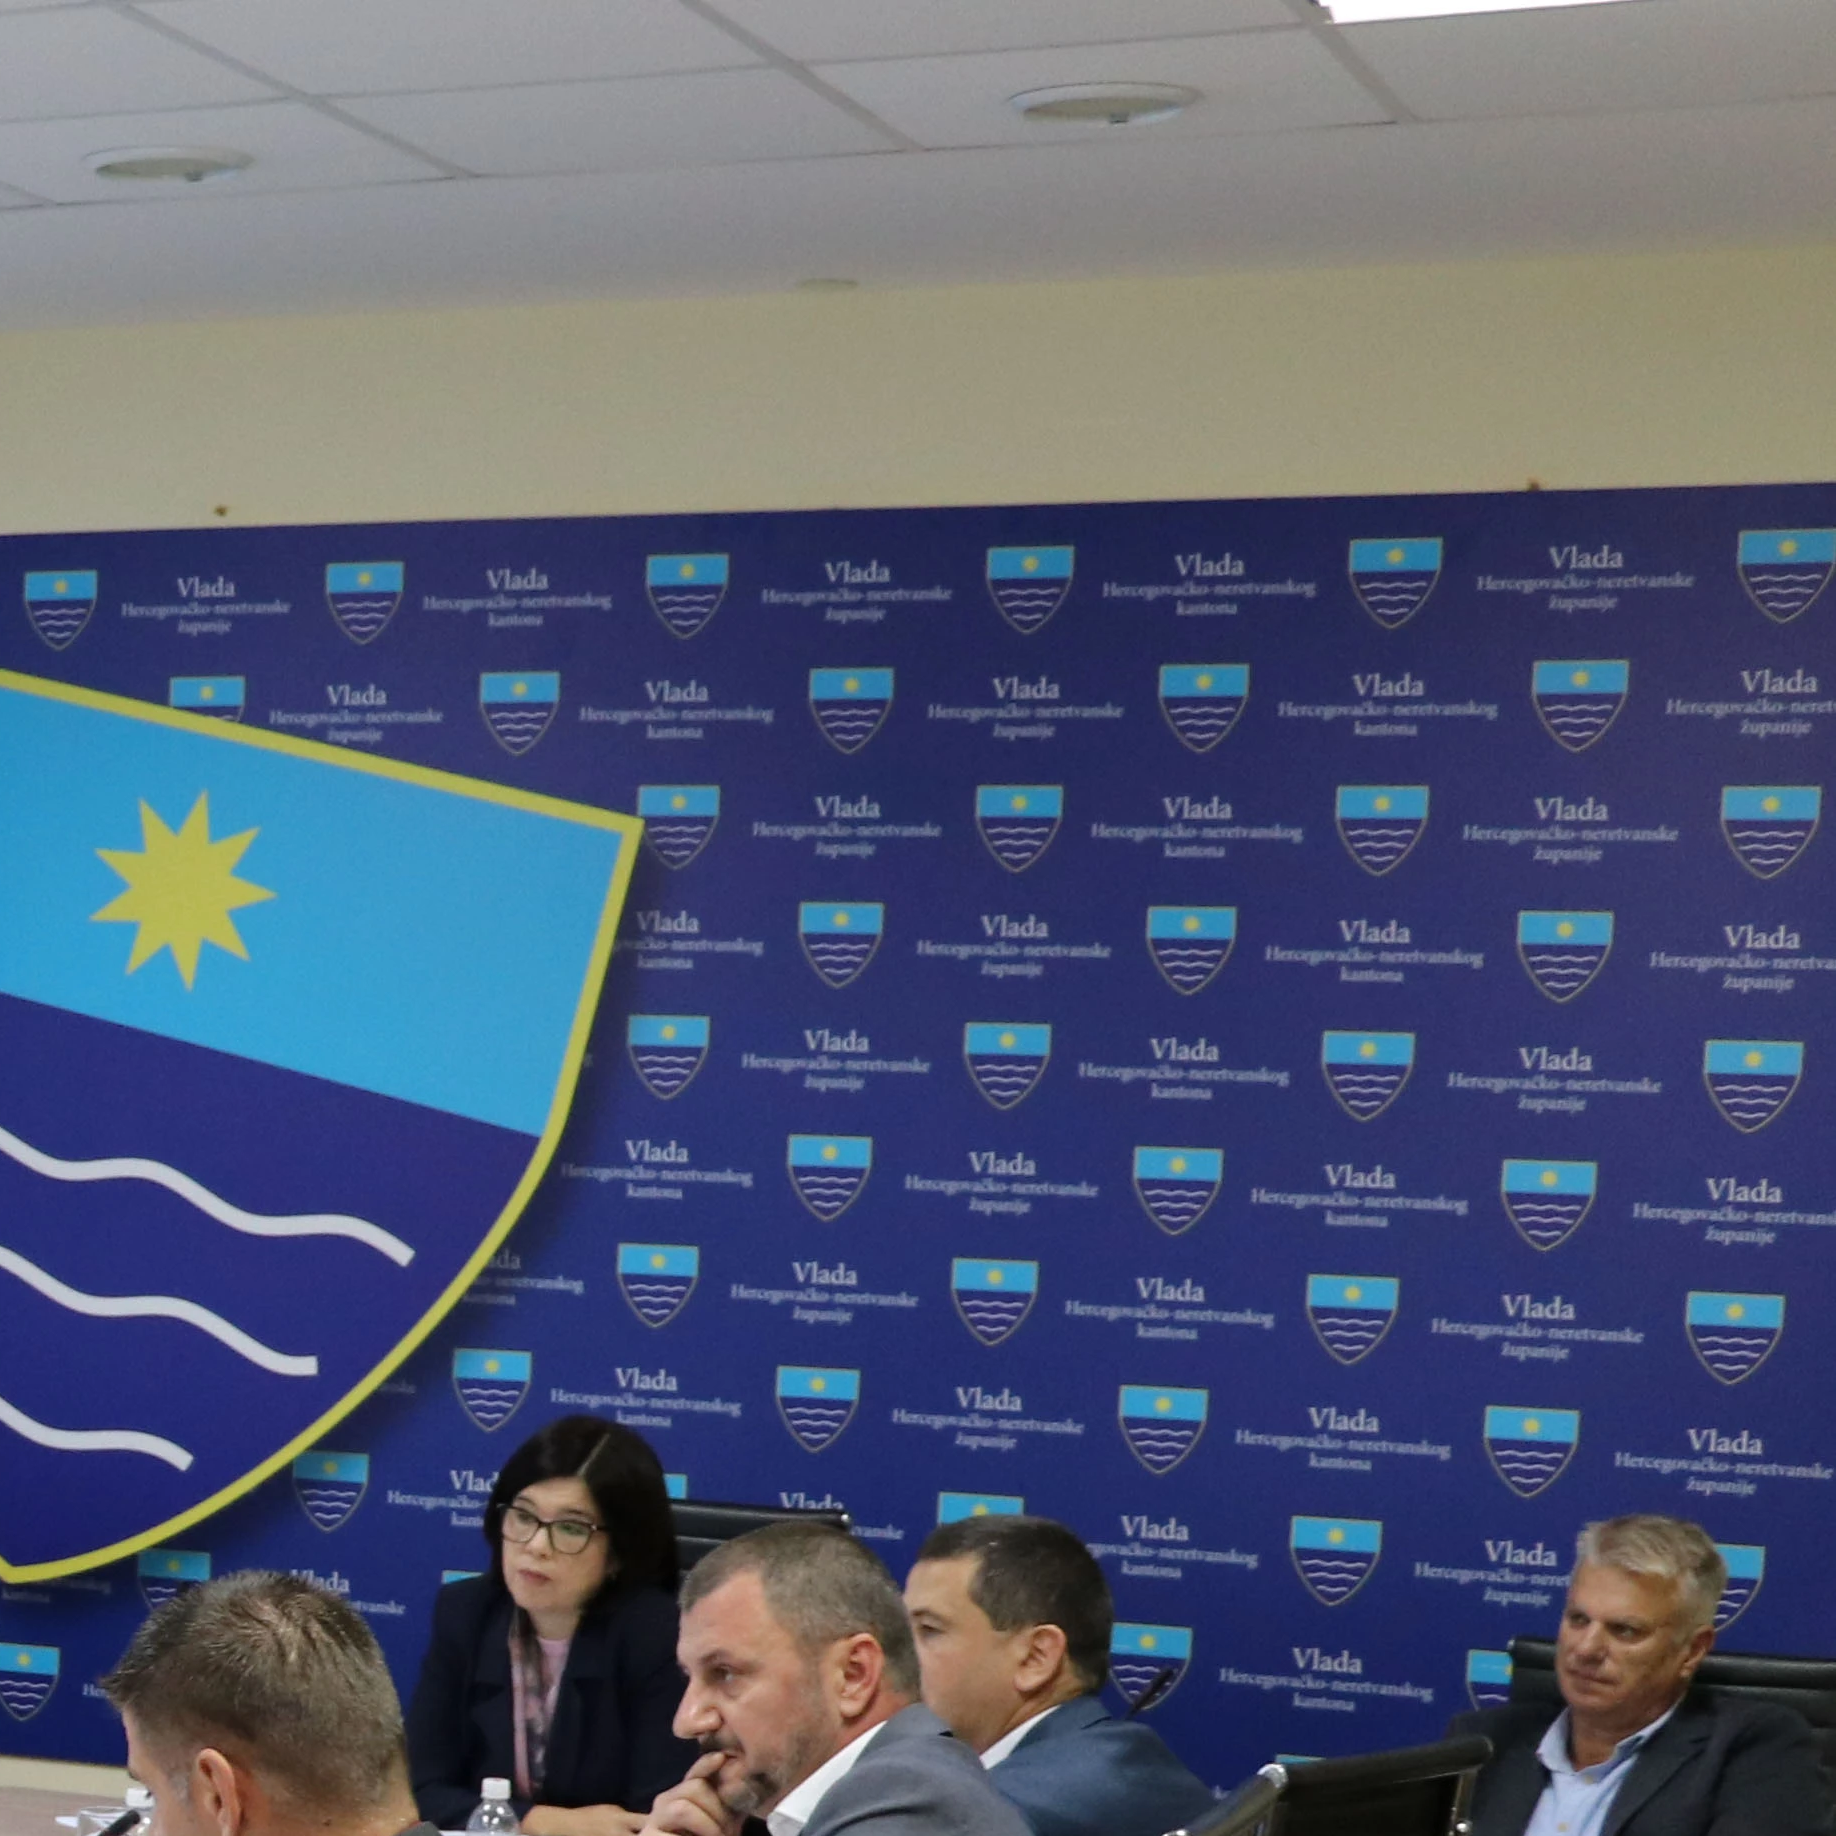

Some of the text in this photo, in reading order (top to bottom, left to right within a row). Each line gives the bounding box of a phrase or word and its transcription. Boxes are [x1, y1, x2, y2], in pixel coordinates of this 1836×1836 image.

[1174, 551, 1245, 577] Vlada
[1548, 544, 1624, 570] Vlada
[485, 566, 549, 591] Vlada
[823, 558, 891, 584] Vlada
[176, 575, 236, 598] Vlada
[487, 613, 544, 627] kantona
[1175, 600, 1238, 616] kantona
[644, 679, 710, 703] Vlada
[991, 675, 1061, 700] Vlada
[1351, 671, 1425, 697] Vlada
[1739, 667, 1819, 694] Vlada
[326, 683, 388, 707] Vlada
[646, 724, 704, 740] kantona
[1353, 720, 1418, 737] kantona
[814, 794, 881, 819] Vlada
[1161, 794, 1233, 821] Vlada
[1533, 796, 1609, 822] Vlada
[1163, 842, 1226, 859] kantona
[638, 909, 701, 934] Vlada
[980, 913, 1049, 939] Vlada
[1338, 918, 1412, 945] Vlada
[1723, 923, 1801, 950] Vlada
[637, 956, 694, 970] kantona
[1339, 965, 1404, 983] kantona
[803, 1028, 870, 1054] Vlada
[1148, 1036, 1220, 1063] Vlada
[1518, 1045, 1594, 1073] Vlada
[1150, 1082, 1213, 1101] kantona
[624, 1138, 690, 1164] Vlada
[967, 1150, 1037, 1177] Vlada
[1322, 1163, 1397, 1190] Vlada
[625, 1182, 684, 1200] kantona
[1705, 1176, 1784, 1205] Vlada
[1324, 1209, 1389, 1229] kantona
[791, 1260, 859, 1287] Vlada
[1134, 1276, 1206, 1304] Vlada
[1500, 1293, 1577, 1322] Vlada
[1136, 1322, 1198, 1341] kantona
[613, 1366, 679, 1393] Vlada
[954, 1385, 1023, 1413] Vlada
[615, 1409, 672, 1429] kantona
[1307, 1405, 1381, 1434] Vlada
[1686, 1427, 1764, 1456] Vlada
[1308, 1451, 1373, 1472] kantona
[448, 1468, 500, 1494] Vlad
[1119, 1514, 1190, 1543] Vlada
[1483, 1538, 1557, 1567] Vlada
[1120, 1559, 1183, 1580] kantona
[1291, 1646, 1363, 1675] Vlada
[1292, 1691, 1356, 1713] kantona
